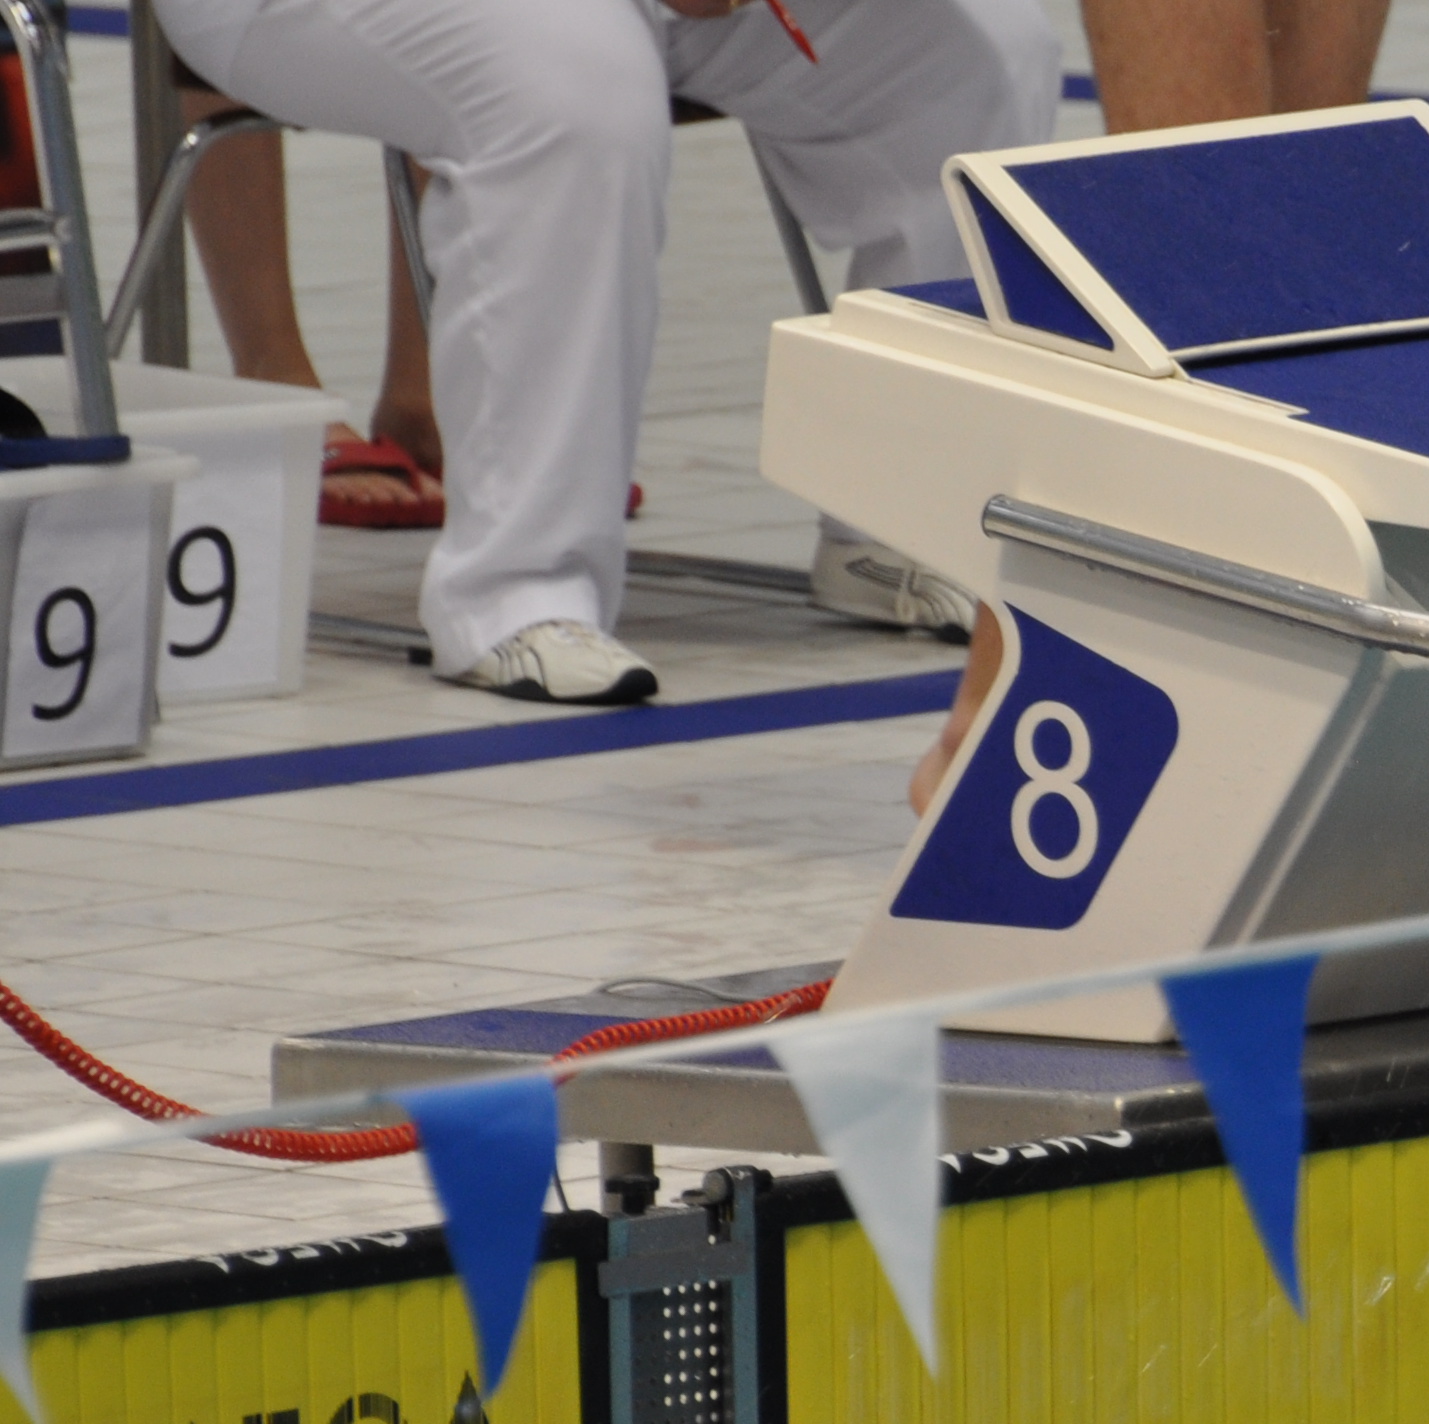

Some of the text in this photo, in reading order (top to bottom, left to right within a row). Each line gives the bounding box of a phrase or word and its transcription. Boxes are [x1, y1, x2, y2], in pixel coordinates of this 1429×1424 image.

[31, 586, 97, 721] 9
[167, 525, 236, 658] 9
[1011, 700, 1099, 878] 8
